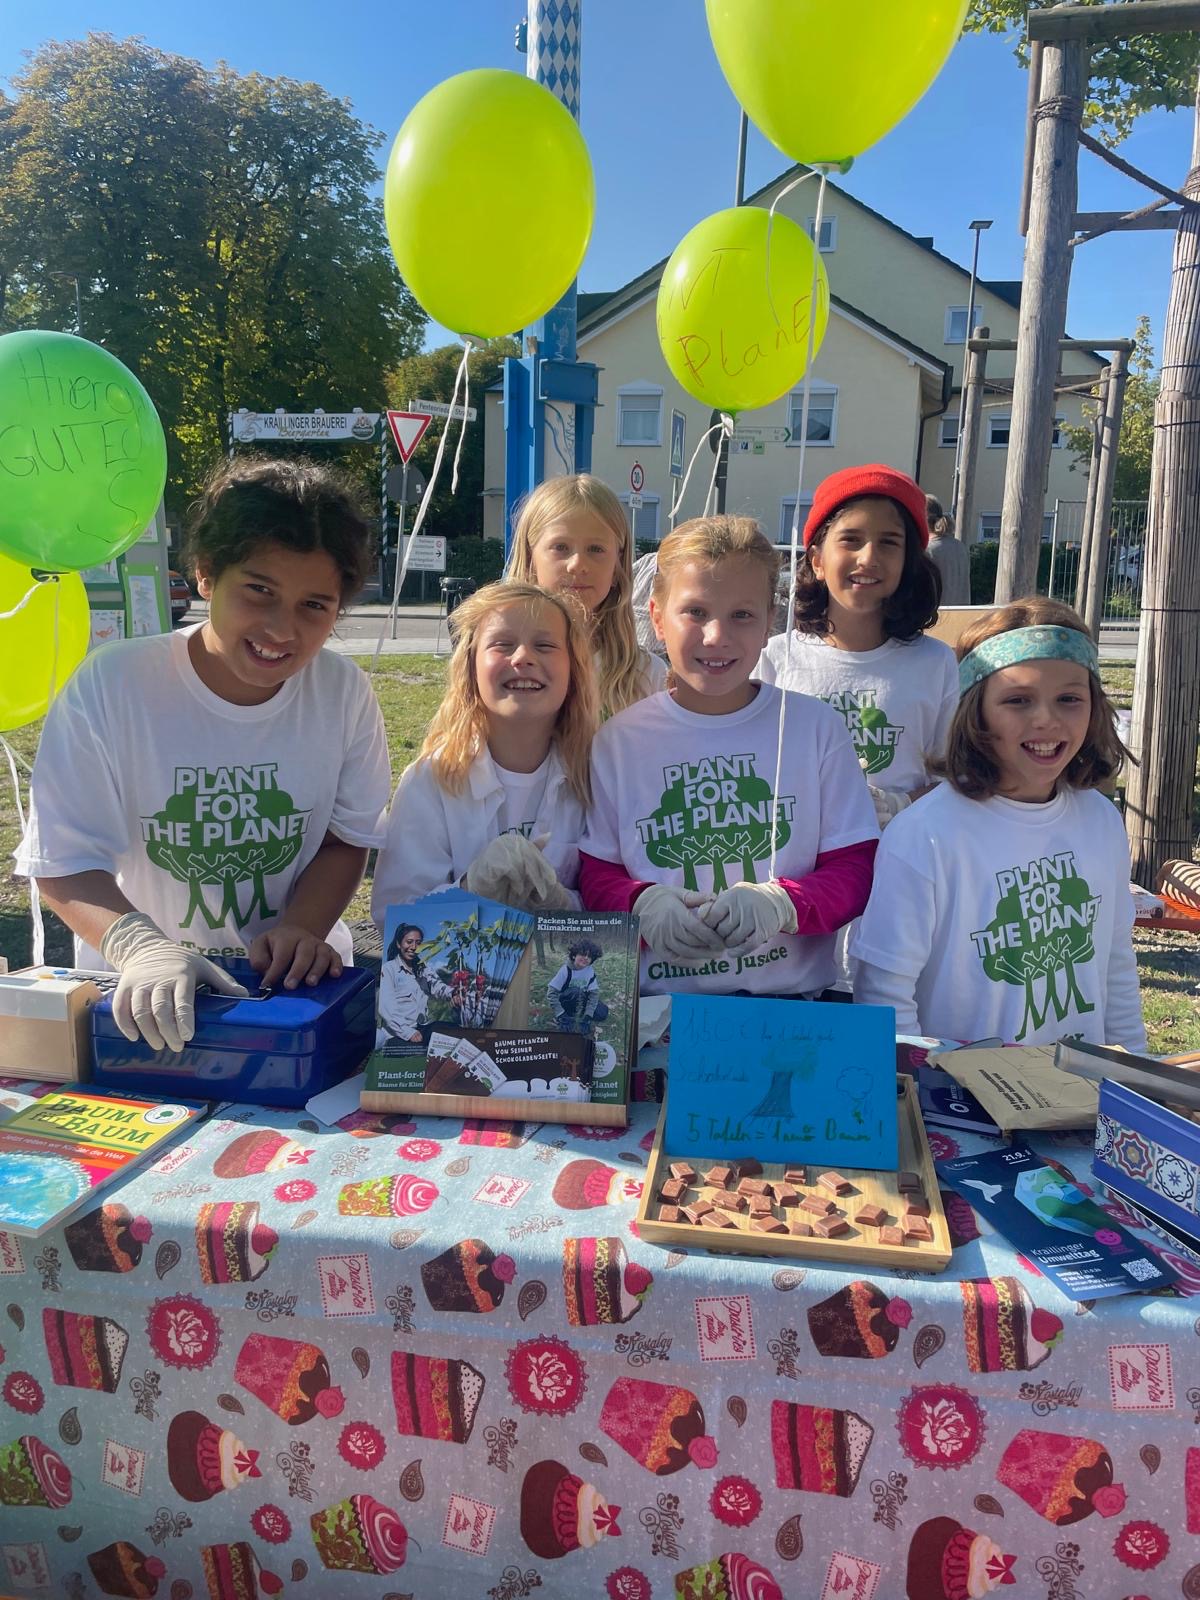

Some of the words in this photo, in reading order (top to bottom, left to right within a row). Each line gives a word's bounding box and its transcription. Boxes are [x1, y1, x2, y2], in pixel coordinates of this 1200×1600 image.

[311, 417, 348, 429] BRAUEREI
[174, 763, 279, 795] PLANT
[662, 753, 756, 790] PLANT
[194, 793, 260, 822] FOR
[683, 779, 741, 809] FOR
[139, 816, 192, 847] THE
[203, 808, 314, 847] PLANET
[635, 811, 685, 845] THE
[692, 795, 797, 830] PLANET
[995, 850, 1075, 900] PLANT
[1018, 882, 1063, 920] FOR
[537, 916, 566, 925] Packen
[567, 917, 579, 925] Sie
[609, 917, 622, 925] die
[537, 924, 581, 932] Klimakrise
[582, 924, 595, 932] an!
[970, 922, 1023, 959] THE
[1028, 894, 1102, 943] PLANET
[495, 1047, 509, 1055] VON
[510, 1046, 533, 1054] SEINER
[517, 1036, 549, 1046] PFLANZEN
[495, 1052, 559, 1064] SCHOKOLADENSEITE!
[44, 1097, 142, 1124] BAUM
[29, 1111, 66, 1127] für
[56, 1116, 153, 1145] BAUM
[89, 1148, 103, 1157] die
[103, 1150, 126, 1161] Welt
[1030, 1242, 1085, 1256] Kraillinger
[1037, 1249, 1101, 1264] Umwelttag
